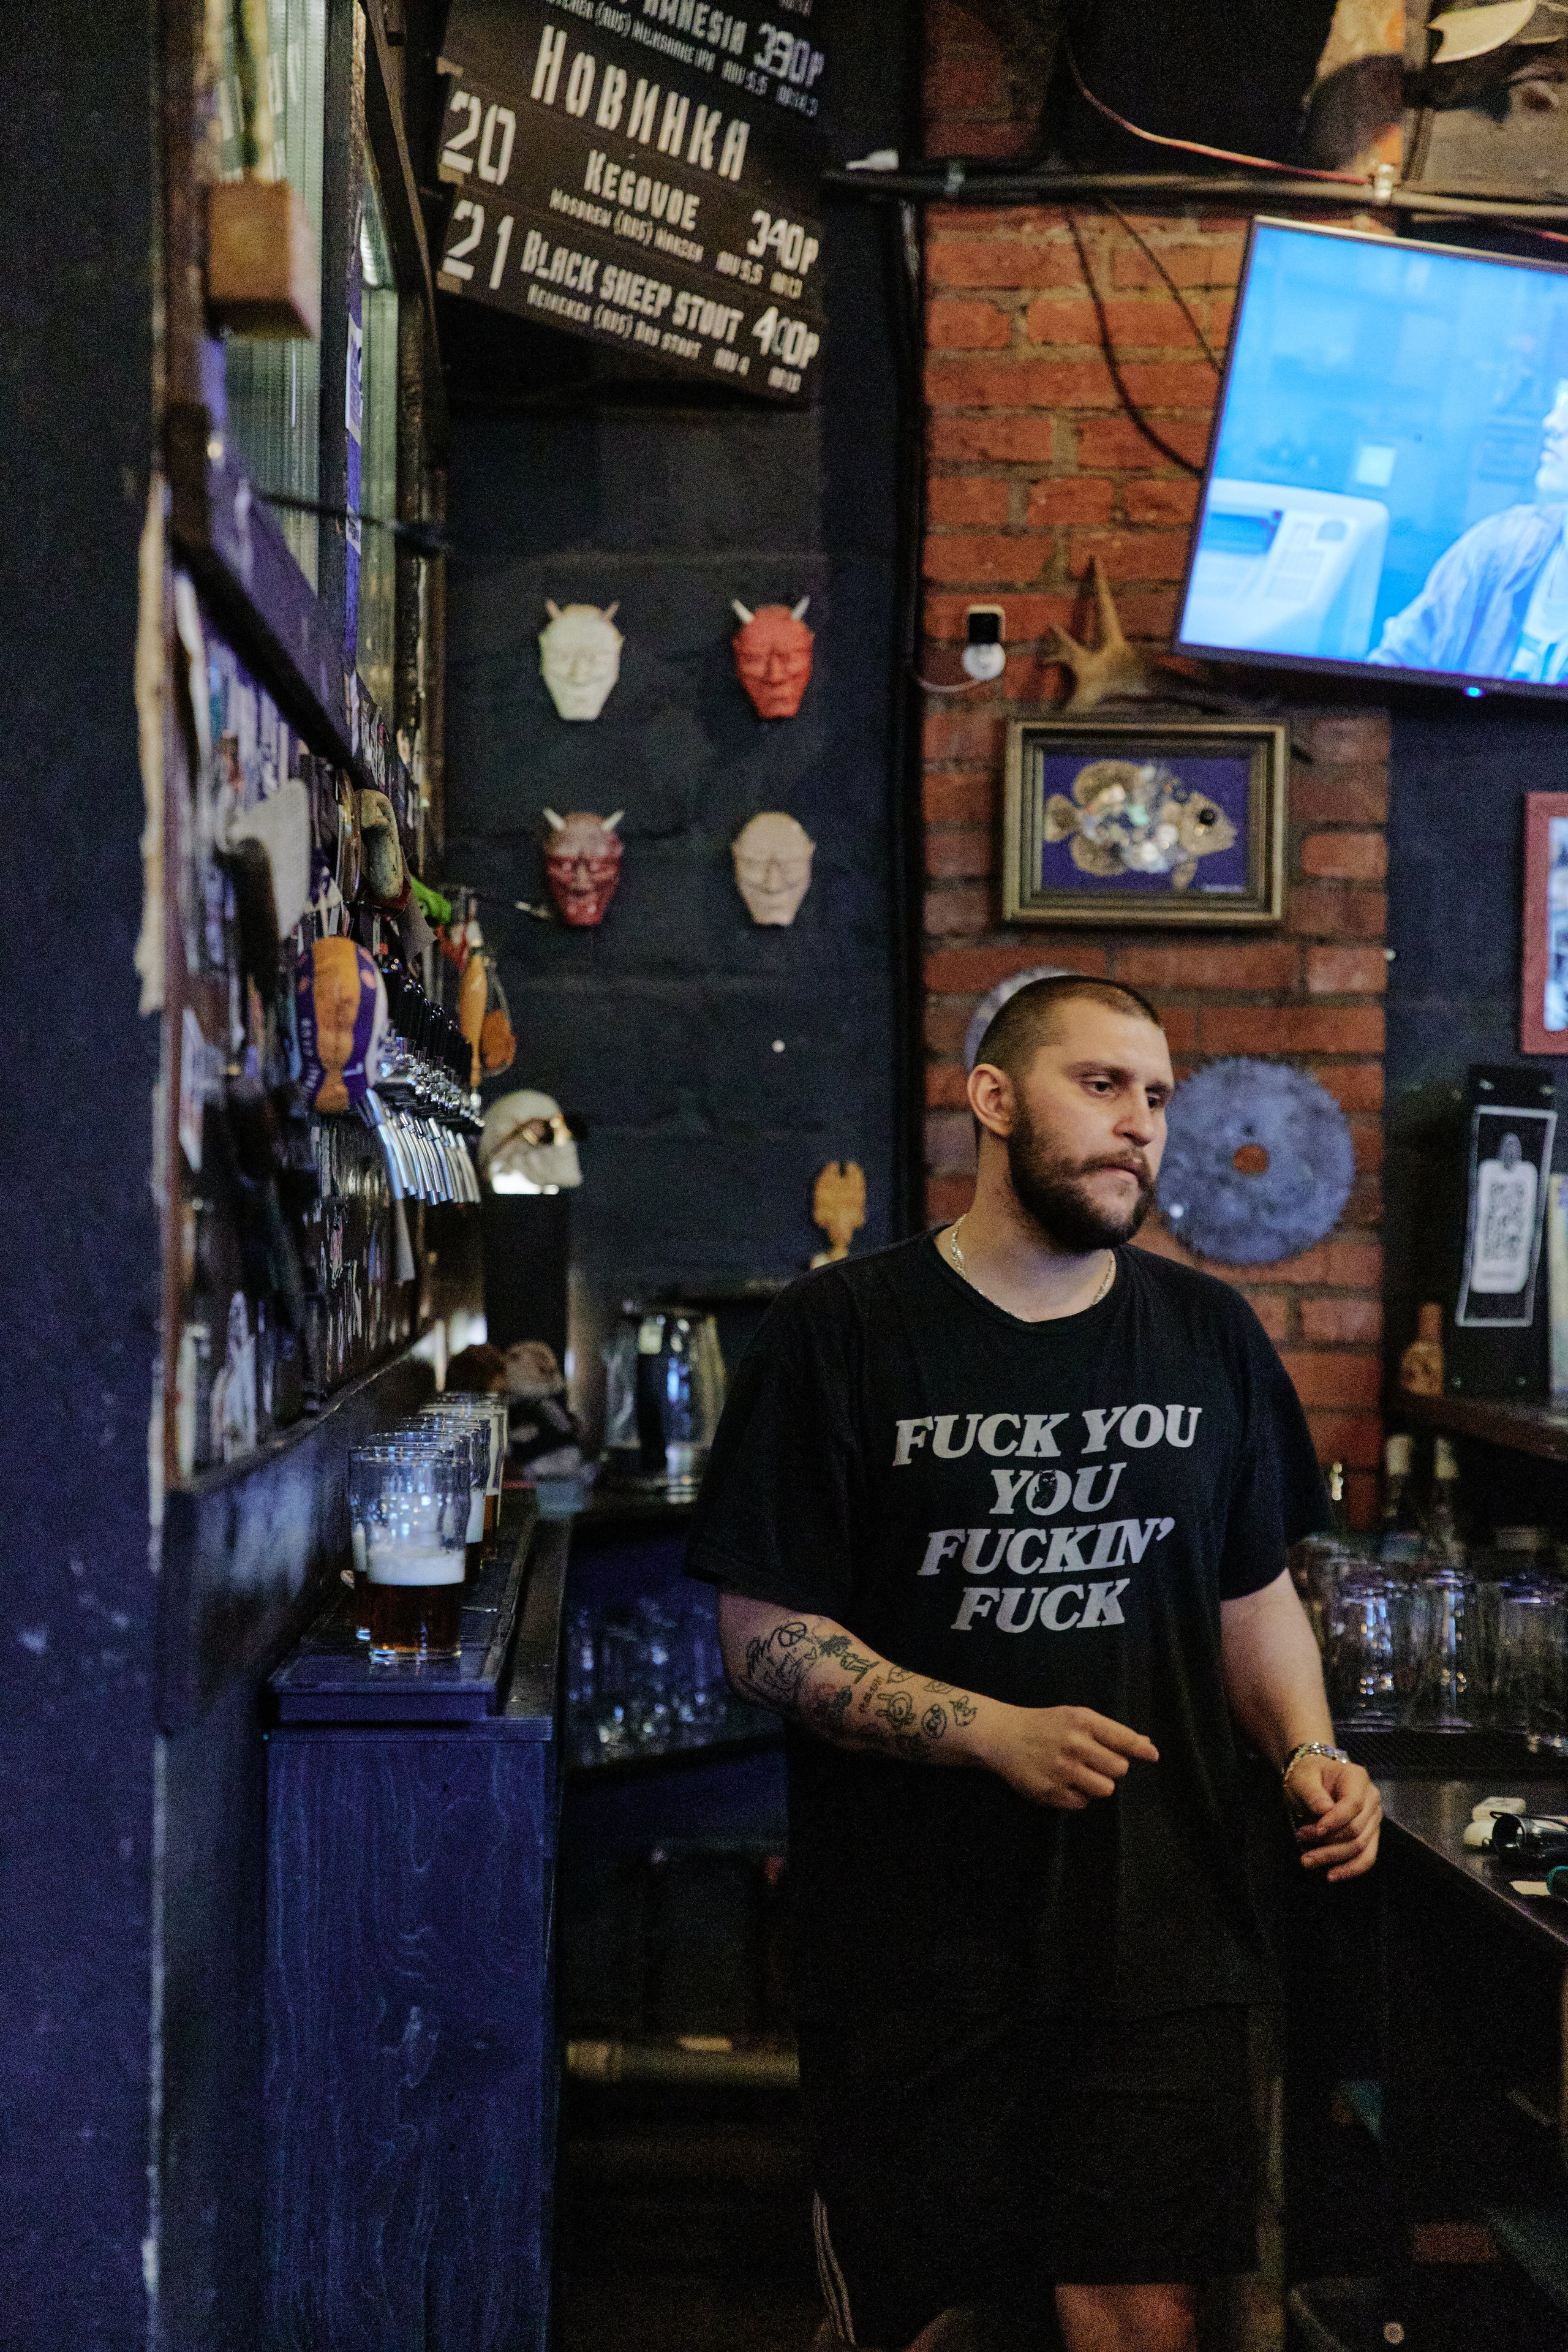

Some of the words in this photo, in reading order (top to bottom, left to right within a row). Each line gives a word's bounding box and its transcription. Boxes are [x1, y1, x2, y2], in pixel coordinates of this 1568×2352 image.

[442, 91, 516, 184] 20
[530, 24, 750, 181] НОВИНКА
[584, 149, 700, 231] KEGOVOE
[442, 200, 514, 290] 21
[521, 230, 600, 294] BLACK
[600, 265, 673, 318] SHEEP
[673, 291, 744, 343] STOUT
[892, 1412, 1069, 1466] FUCK
[1080, 1403, 1202, 1454] YOU
[989, 1462, 1128, 1516] YOU
[917, 1517, 1175, 1576] FUCKIN'
[951, 1578, 1131, 1634] FUCK
